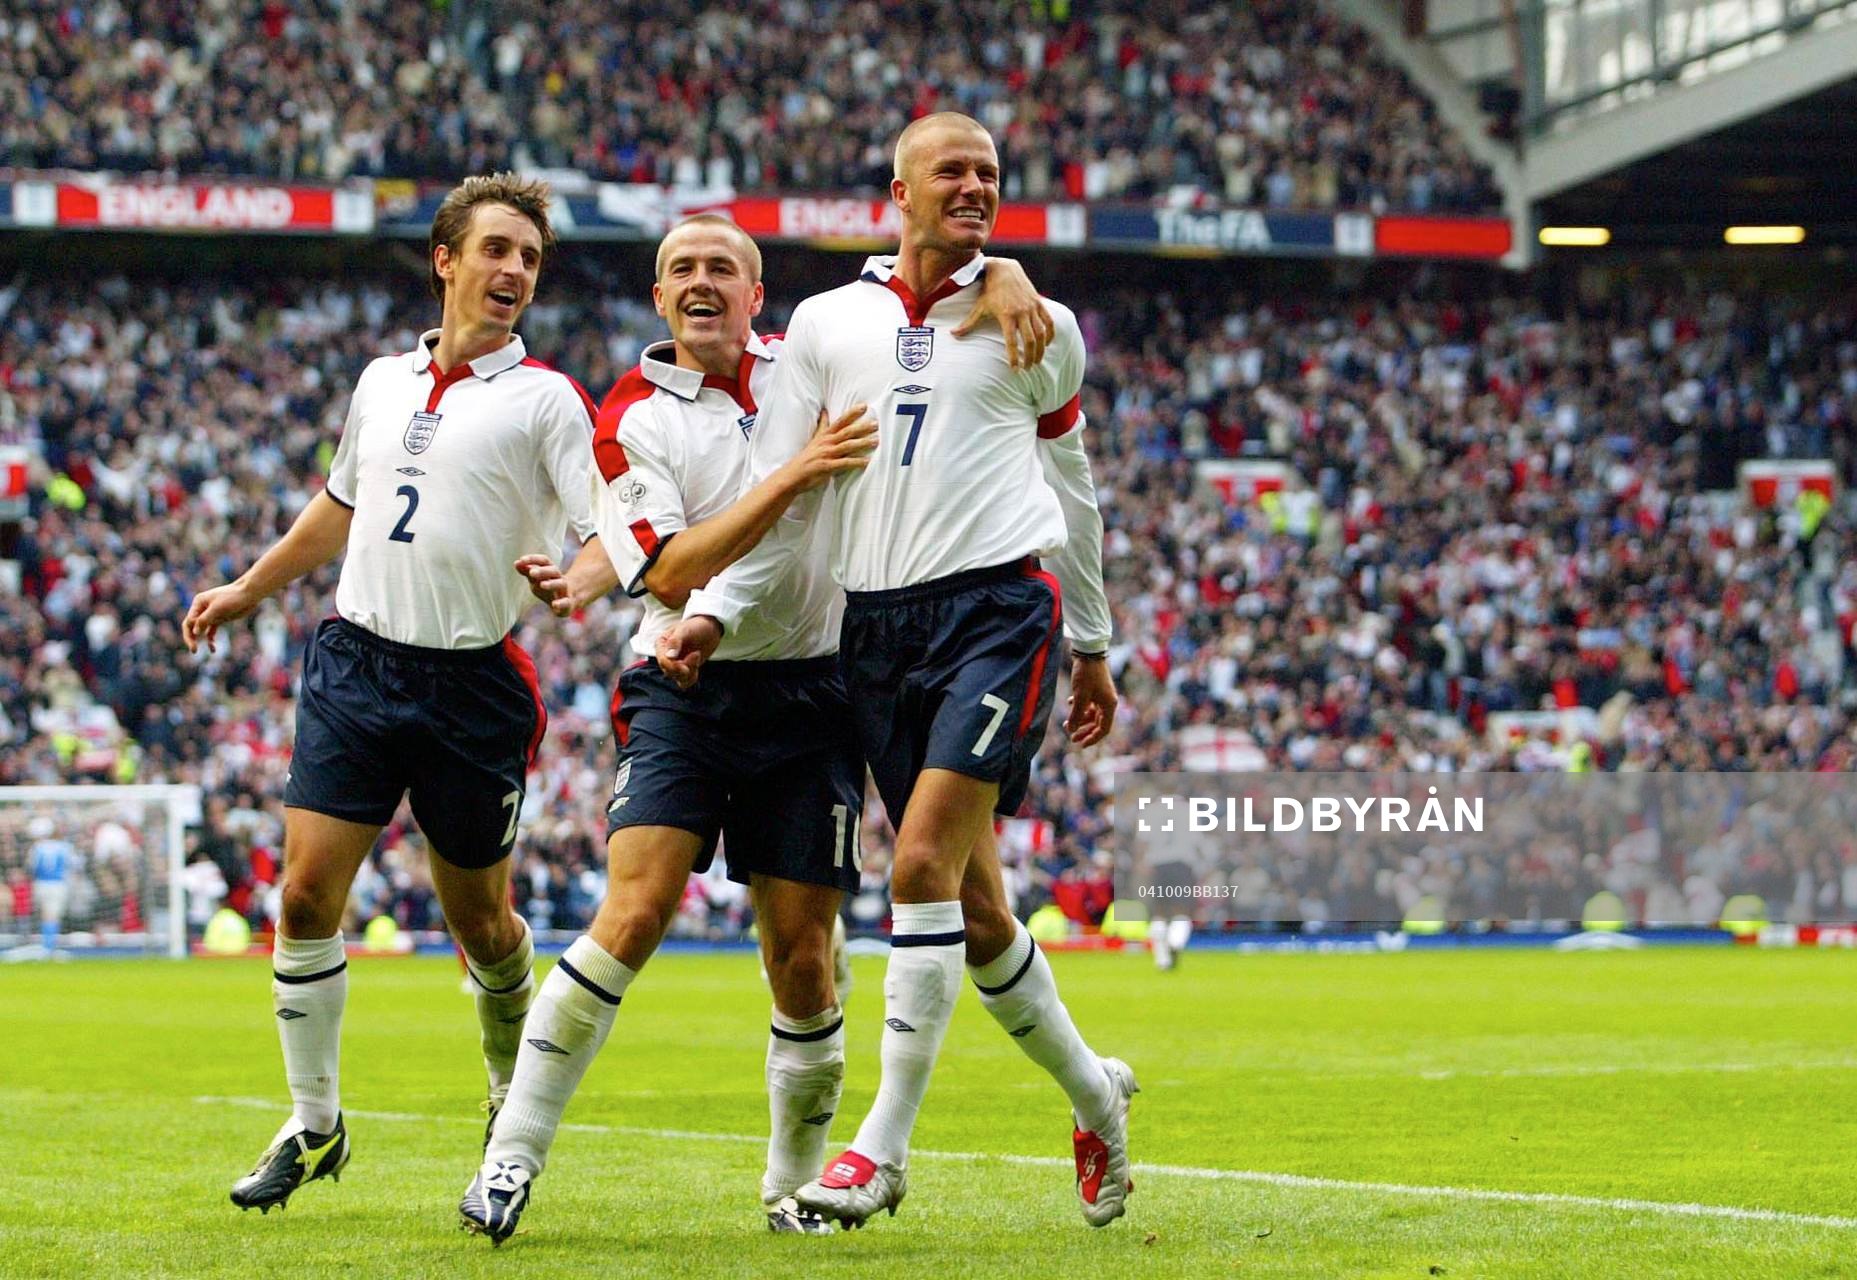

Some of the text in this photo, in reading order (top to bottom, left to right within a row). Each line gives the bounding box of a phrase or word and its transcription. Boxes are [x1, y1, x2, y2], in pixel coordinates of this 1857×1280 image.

[99, 184, 288, 227] ENGLAND
[781, 198, 901, 236] ENGLA
[896, 403, 929, 467] 7
[388, 484, 420, 544] 2
[971, 693, 1010, 757] 7
[500, 790, 520, 847] 2
